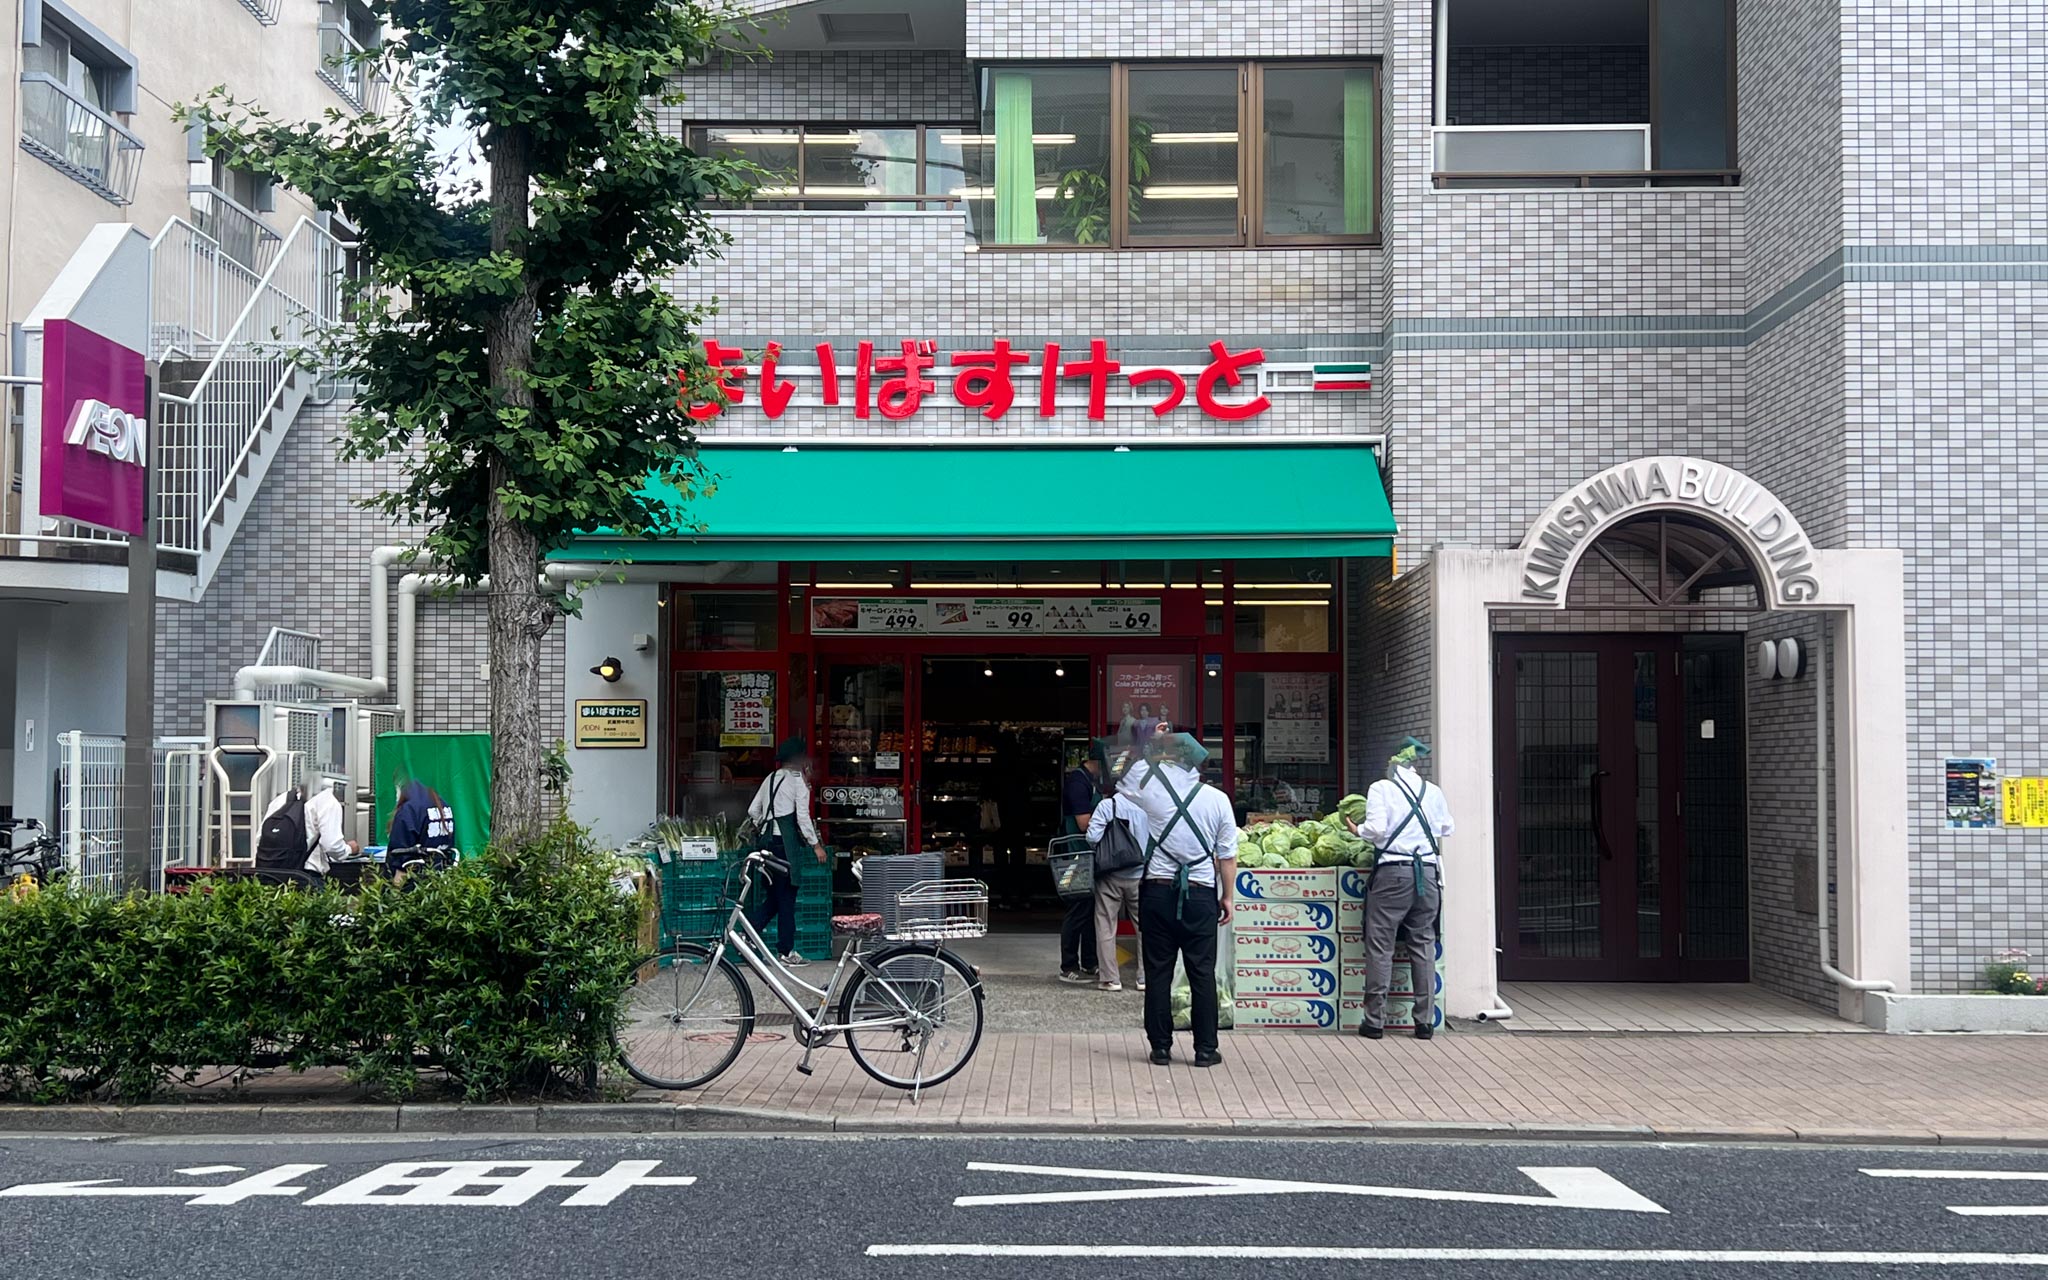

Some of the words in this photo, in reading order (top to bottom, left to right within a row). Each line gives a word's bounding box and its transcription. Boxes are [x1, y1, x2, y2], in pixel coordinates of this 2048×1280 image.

[677, 337, 1271, 420] まいばすけっと
[63, 399, 146, 468] AEON
[1522, 462, 1672, 599] KIMISHIMA
[1678, 462, 1820, 601] BUILDING
[582, 707, 639, 716] まいばすけっと
[581, 724, 600, 732] AEON
[856, 808, 886, 816] 年中無休
[1302, 889, 1335, 898] きゃべつ
[1235, 904, 1266, 912] きゃべつ
[1237, 936, 1269, 944] きゃべつ
[1237, 969, 1269, 977] きゃべつ
[1236, 1001, 1268, 1009] きゃべつ
